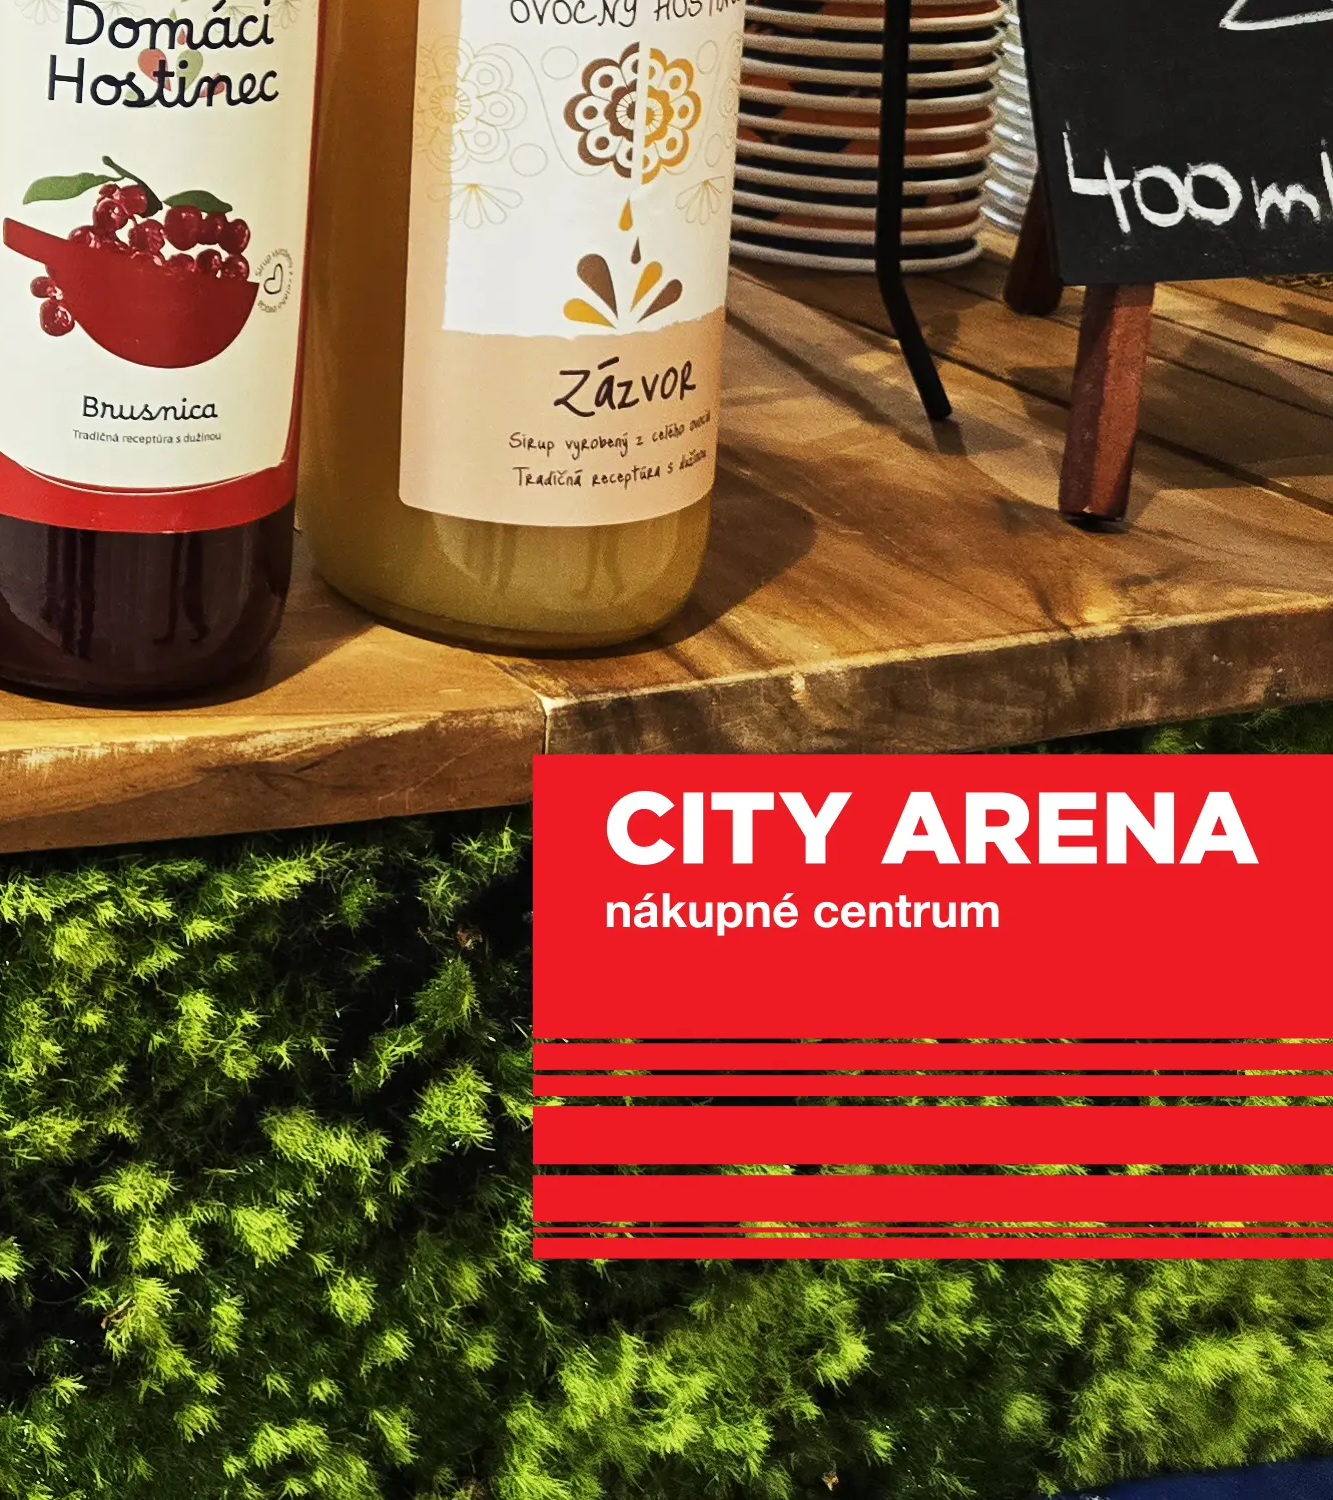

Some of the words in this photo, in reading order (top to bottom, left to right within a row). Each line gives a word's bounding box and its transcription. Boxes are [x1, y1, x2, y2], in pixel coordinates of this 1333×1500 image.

[47, 54, 279, 108] Hostinec
[83, 395, 218, 421] Brusnica
[73, 429, 119, 443] Tradičná
[122, 433, 174, 445] receptúra
[176, 436, 181, 444] s
[183, 431, 222, 443] dužinou
